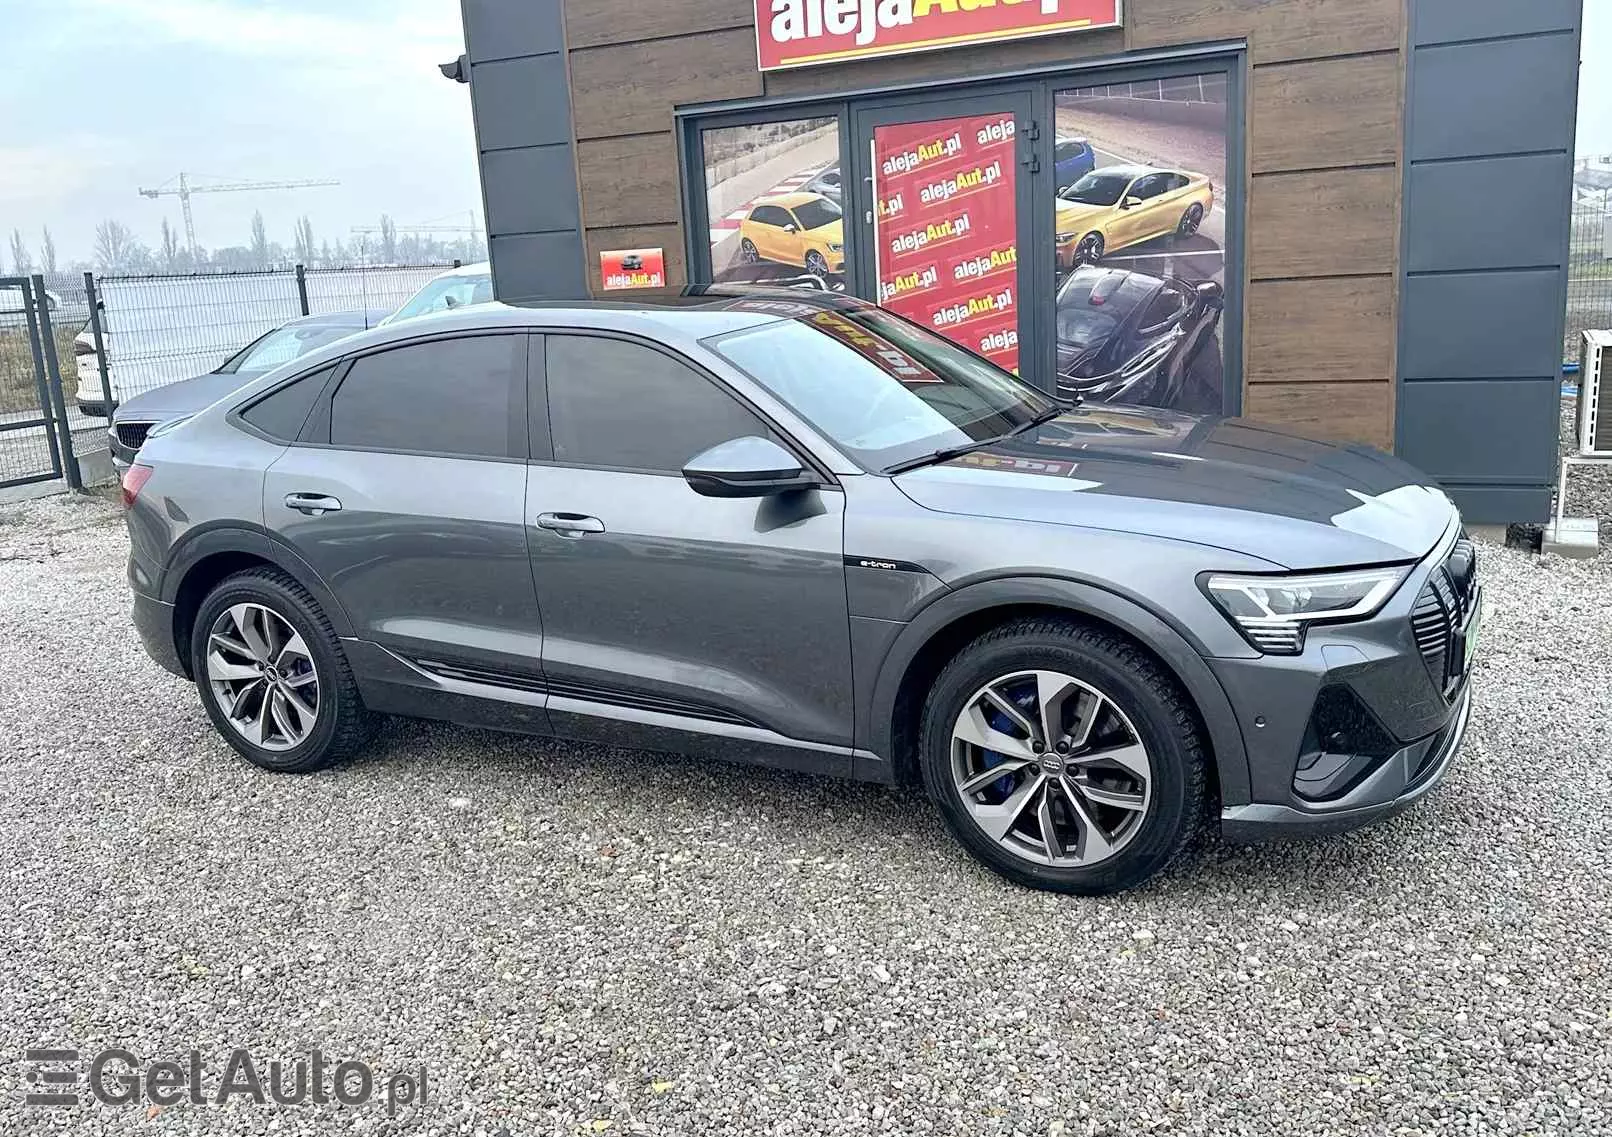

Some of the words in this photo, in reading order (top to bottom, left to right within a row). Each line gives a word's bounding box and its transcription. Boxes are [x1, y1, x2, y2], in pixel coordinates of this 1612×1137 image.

[976, 119, 1015, 145] aleja
[882, 132, 962, 175] alejaAut.pl
[920, 160, 1001, 203] alejaAut.pl
[878, 192, 904, 216] t.pl
[891, 213, 970, 253] alejaAut.pl
[606, 271, 661, 287] alejaAut.pl
[954, 246, 1017, 279] alejaAut
[881, 266, 938, 301] jaAut.pl
[933, 288, 1012, 325] alejaAut.pl
[980, 329, 1018, 351] aleja
[860, 560, 896, 569] e-tron
